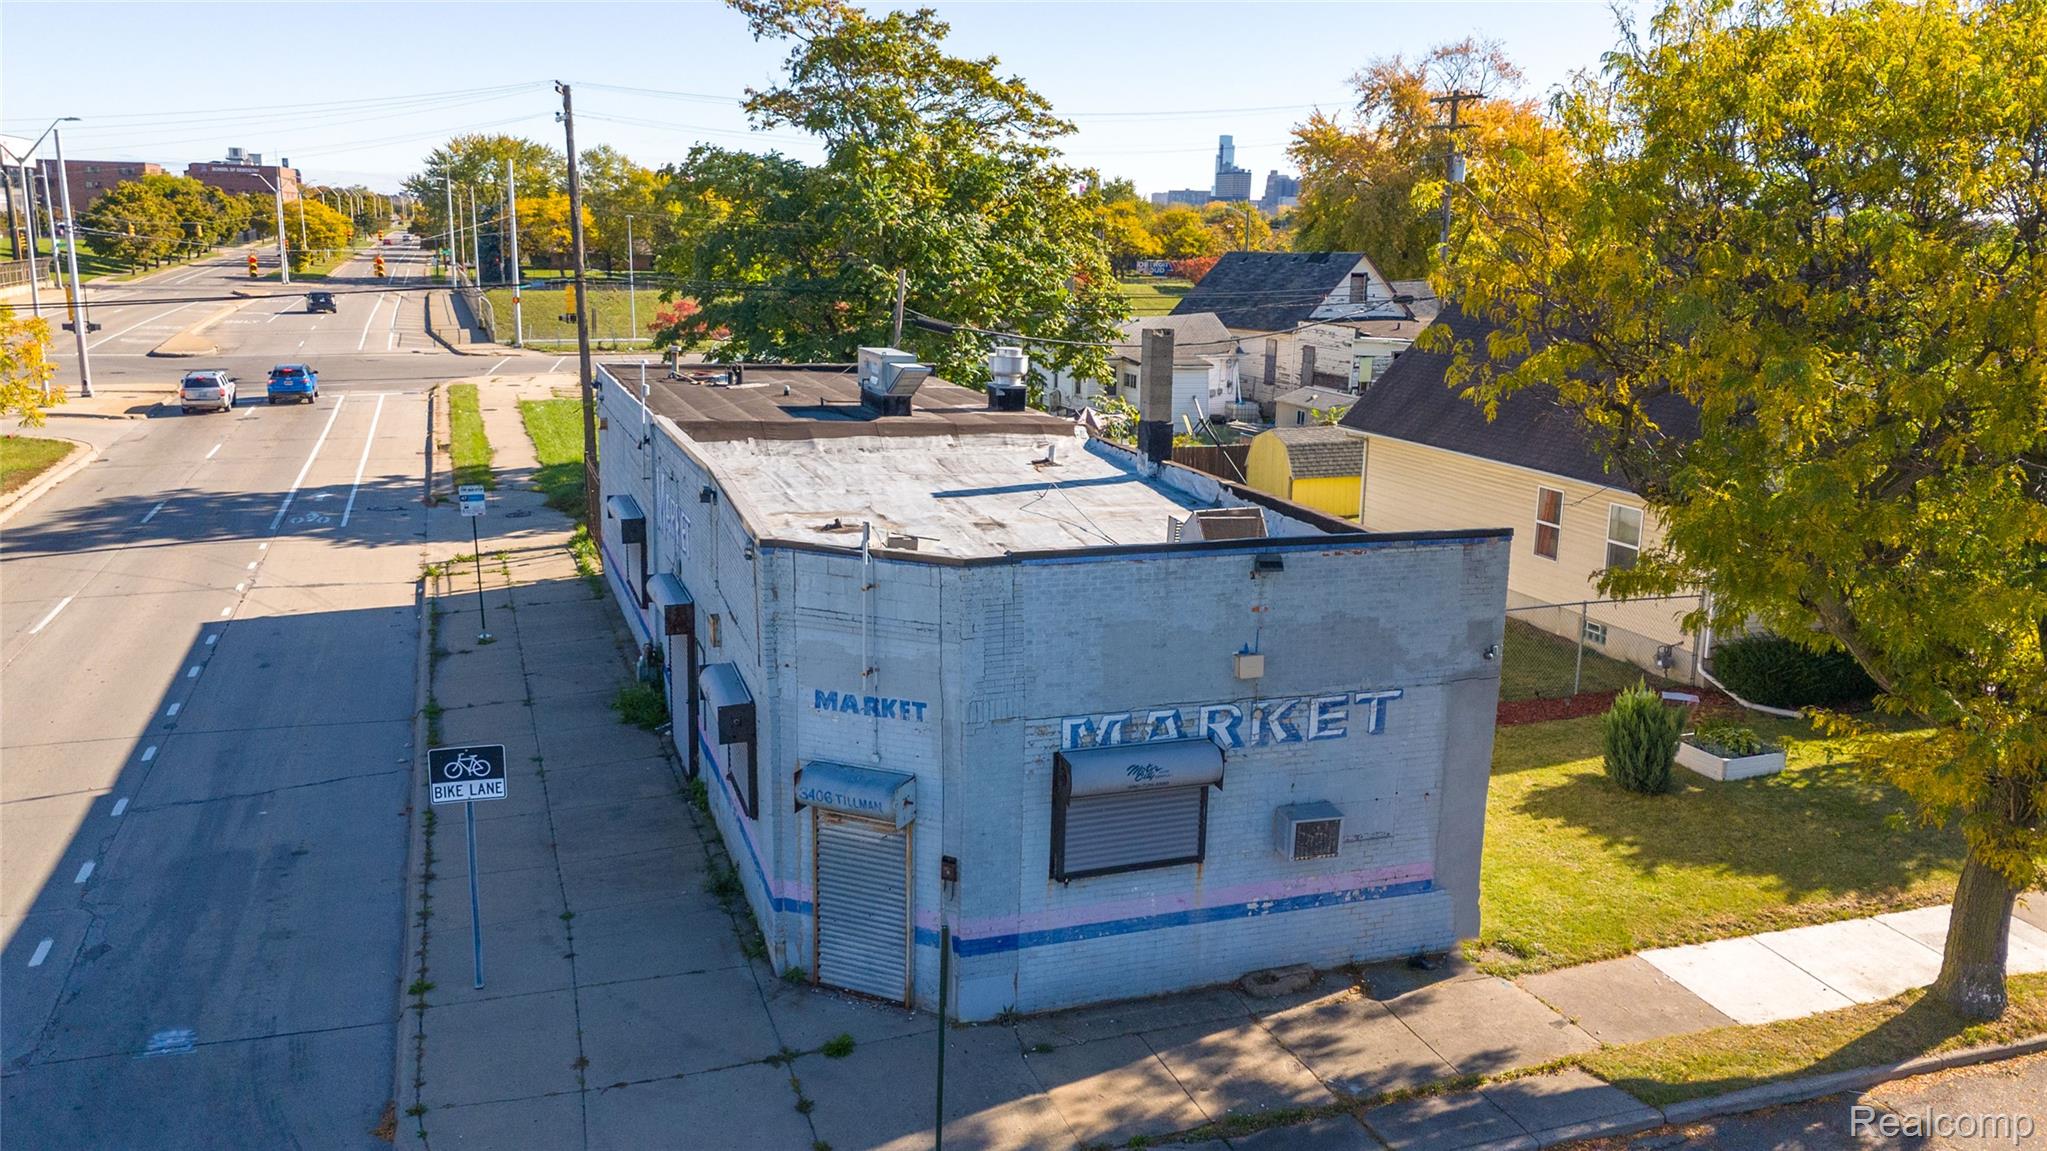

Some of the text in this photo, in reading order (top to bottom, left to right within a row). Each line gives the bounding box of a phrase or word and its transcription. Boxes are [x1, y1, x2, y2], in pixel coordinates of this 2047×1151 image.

[815, 689, 928, 722] MARKET
[1061, 688, 1404, 750] MARKET
[434, 781, 503, 799] BIKE LANE
[835, 793, 883, 812] TILLMAN
